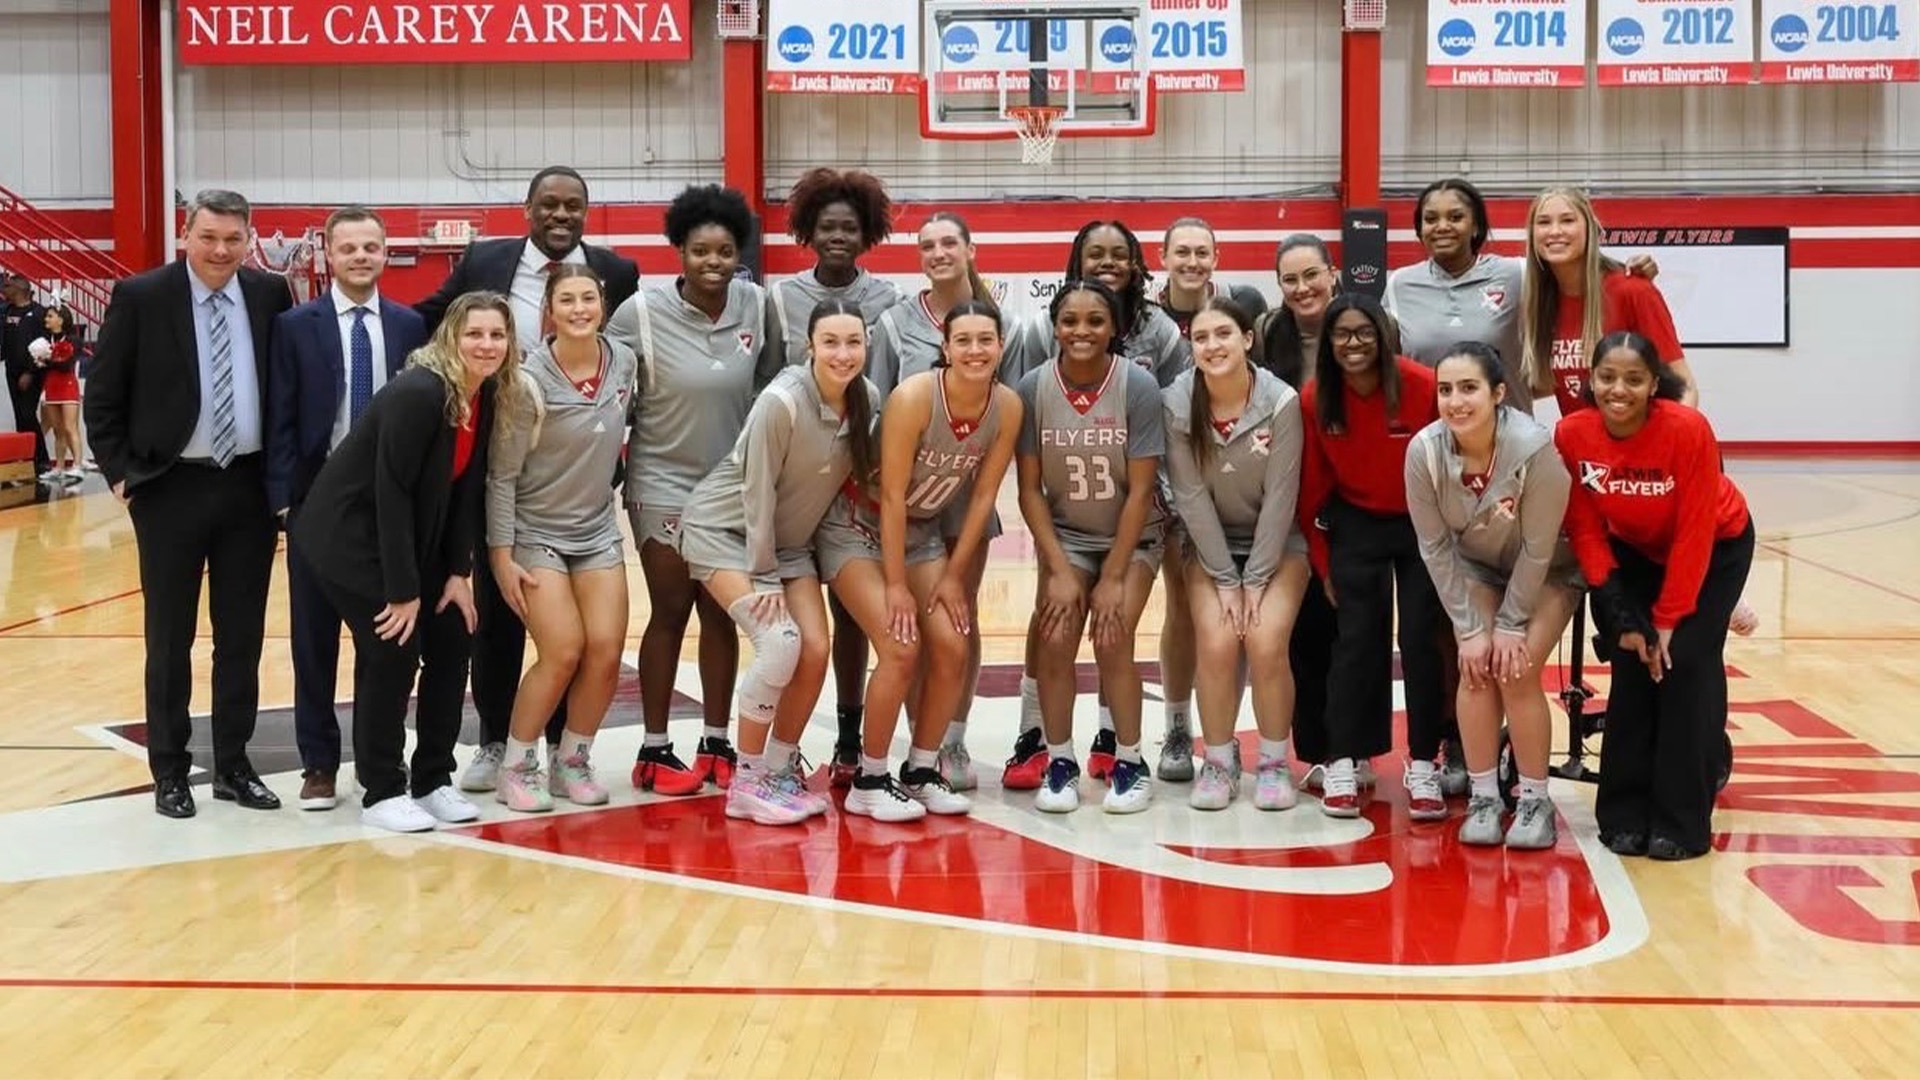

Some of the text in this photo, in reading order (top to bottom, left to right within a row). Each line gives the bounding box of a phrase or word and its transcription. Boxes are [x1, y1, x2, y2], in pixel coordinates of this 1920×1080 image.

[187, 3, 682, 45] NEIL CAREY ARENA
[1494, 10, 1567, 47] 2014
[1662, 7, 1734, 45] 2012
[1816, 4, 1900, 42] 2004
[828, 23, 905, 60] 2021
[995, 19, 1067, 52] 209
[1151, 20, 1227, 58] 2015
[1441, 36, 1476, 48] NCAA
[1610, 35, 1644, 47] NCAA
[1774, 32, 1809, 44] NCAA
[781, 43, 815, 54] NCAA
[1452, 68, 1559, 86] Lewis University
[1622, 65, 1728, 83] Lewis University
[1786, 62, 1893, 81] Lewis University
[791, 74, 894, 93] Lewis University
[957, 74, 994, 90] Lewis
[1115, 73, 1219, 91] Lew University
[441, 221, 468, 237] EXIT
[1599, 229, 1735, 244] LEWIS FLYERS
[1030, 279, 1063, 298] Seni
[1552, 339, 1582, 355] FLYE
[1553, 355, 1587, 369] NATI
[1041, 429, 1128, 447] FLYERS
[1066, 455, 1115, 501] 33
[1608, 475, 1675, 496] FLYERS
[906, 475, 960, 510] 10
